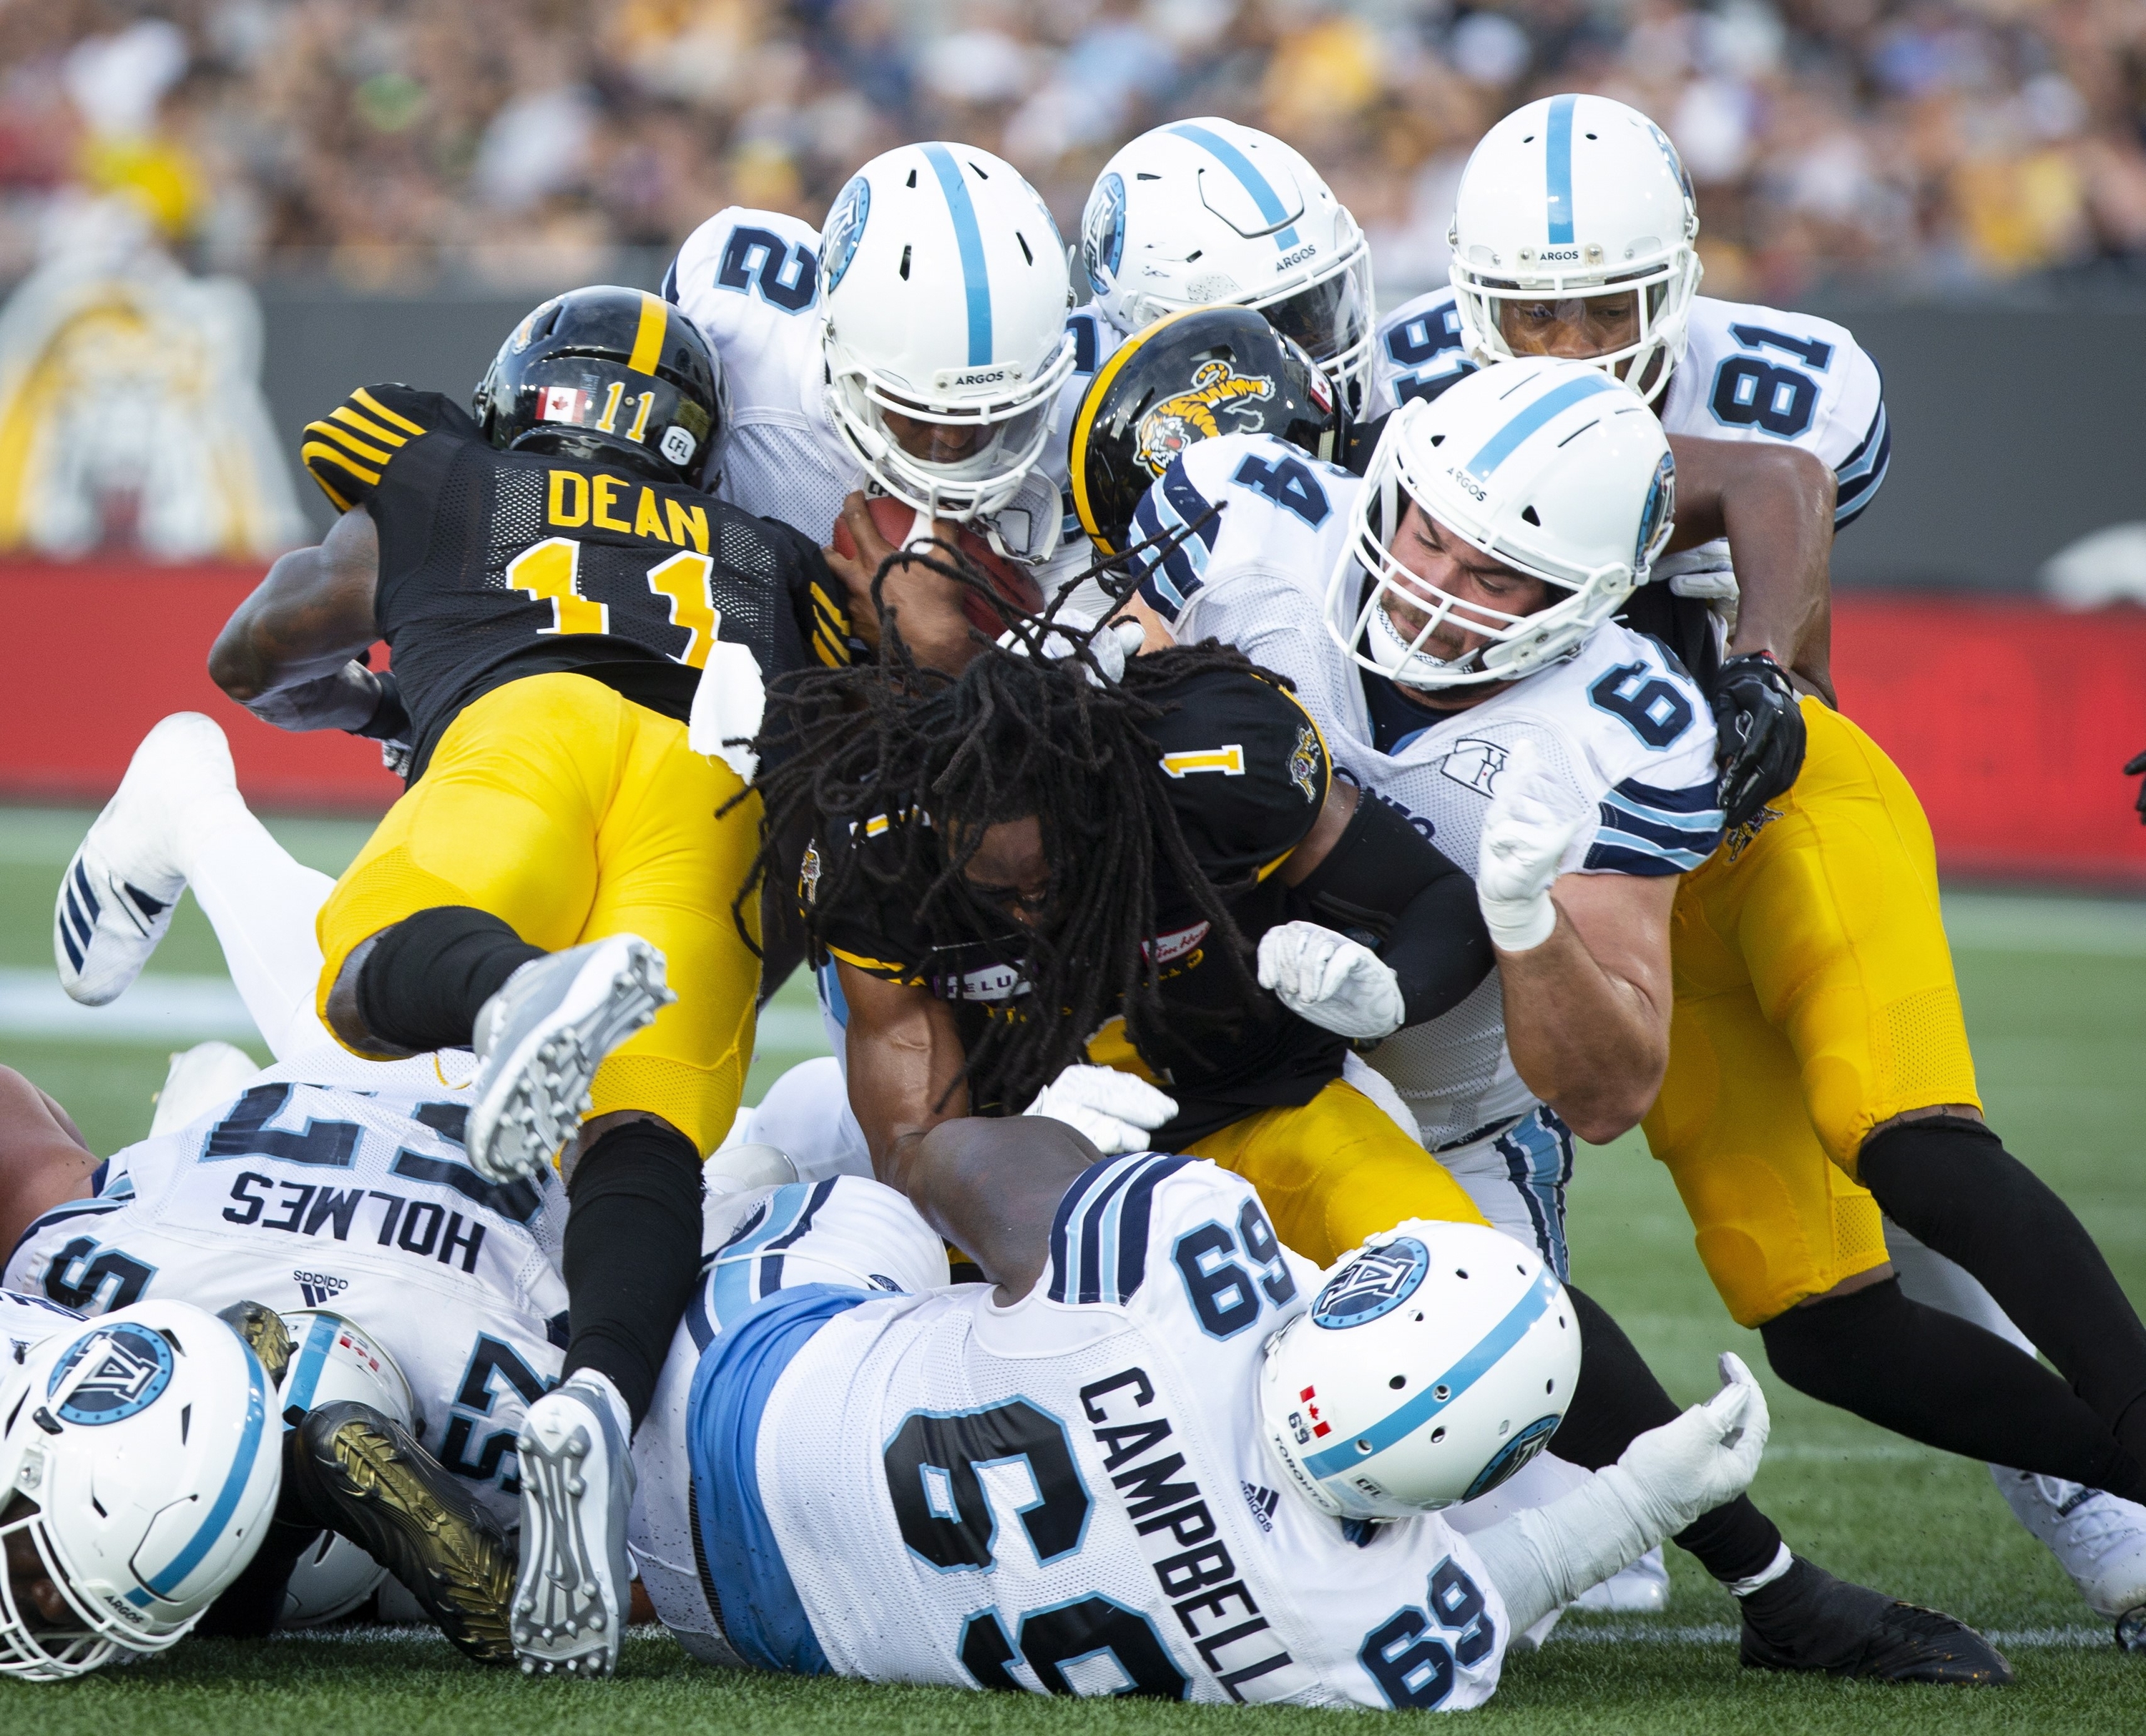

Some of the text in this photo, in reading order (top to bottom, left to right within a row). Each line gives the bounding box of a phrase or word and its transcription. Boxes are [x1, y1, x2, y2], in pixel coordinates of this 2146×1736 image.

[713, 224, 818, 315] 2
[1276, 244, 1316, 272] ARGOS
[1539, 250, 1579, 262] ARGOS
[955, 371, 1004, 385] ARGOS
[1707, 321, 1836, 441] 81
[594, 381, 655, 444] 11
[667, 435, 688, 458] CFL
[867, 479, 893, 497] CF
[1228, 436, 1356, 533] 4
[1446, 466, 1488, 502] ARGOS
[548, 469, 710, 556] DEAN
[505, 536, 721, 670] 11
[1587, 634, 1698, 752] 6
[1158, 744, 1246, 778] 1
[946, 974, 1024, 994] TELU
[222, 1170, 487, 1275] HOLMES
[293, 1270, 349, 1290] adidas
[1170, 1194, 1300, 1343] 69
[1288, 1411, 1311, 1446] 69
[1273, 1433, 1331, 1509] TORONTO
[1355, 1477, 1382, 1500] CFL
[1240, 1479, 1273, 1533] adidas
[1079, 1365, 1294, 1704] CAMPBELL
[102, 1595, 144, 1624] ARGOS
[1356, 1555, 1494, 1711] 69
